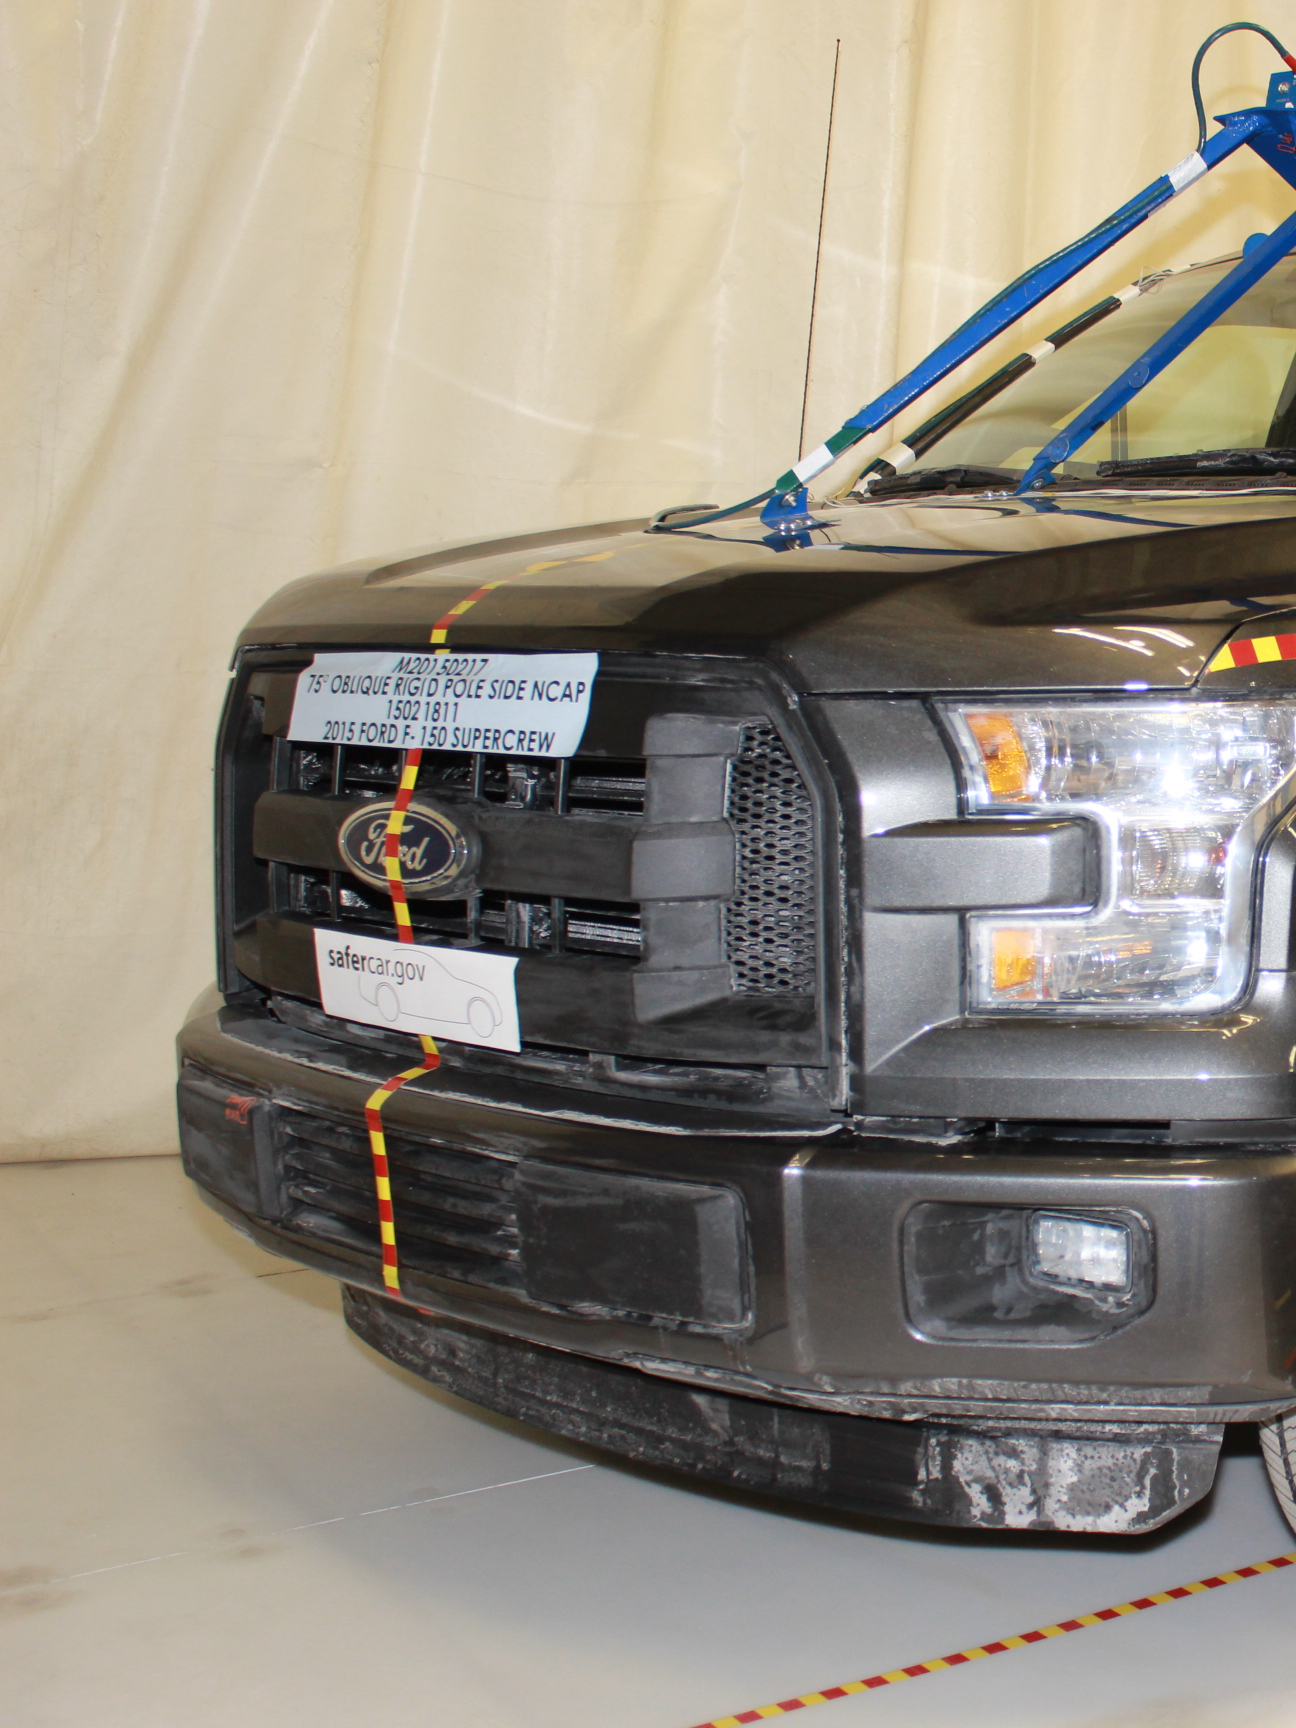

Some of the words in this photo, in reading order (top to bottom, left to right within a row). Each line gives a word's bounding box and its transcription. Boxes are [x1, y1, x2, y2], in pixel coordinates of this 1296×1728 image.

[391, 656, 489, 676] M20150217
[330, 675, 392, 696] OBLIQUE
[393, 677, 439, 698] RIGID
[442, 679, 486, 699] POLE
[487, 679, 528, 700] SIDE
[530, 680, 586, 703] NCAP
[387, 699, 459, 723] 15021811
[322, 720, 356, 742] 2015
[358, 722, 398, 744] FORD
[451, 726, 556, 753] SUPERCREW
[328, 945, 426, 985] safercar.gov
